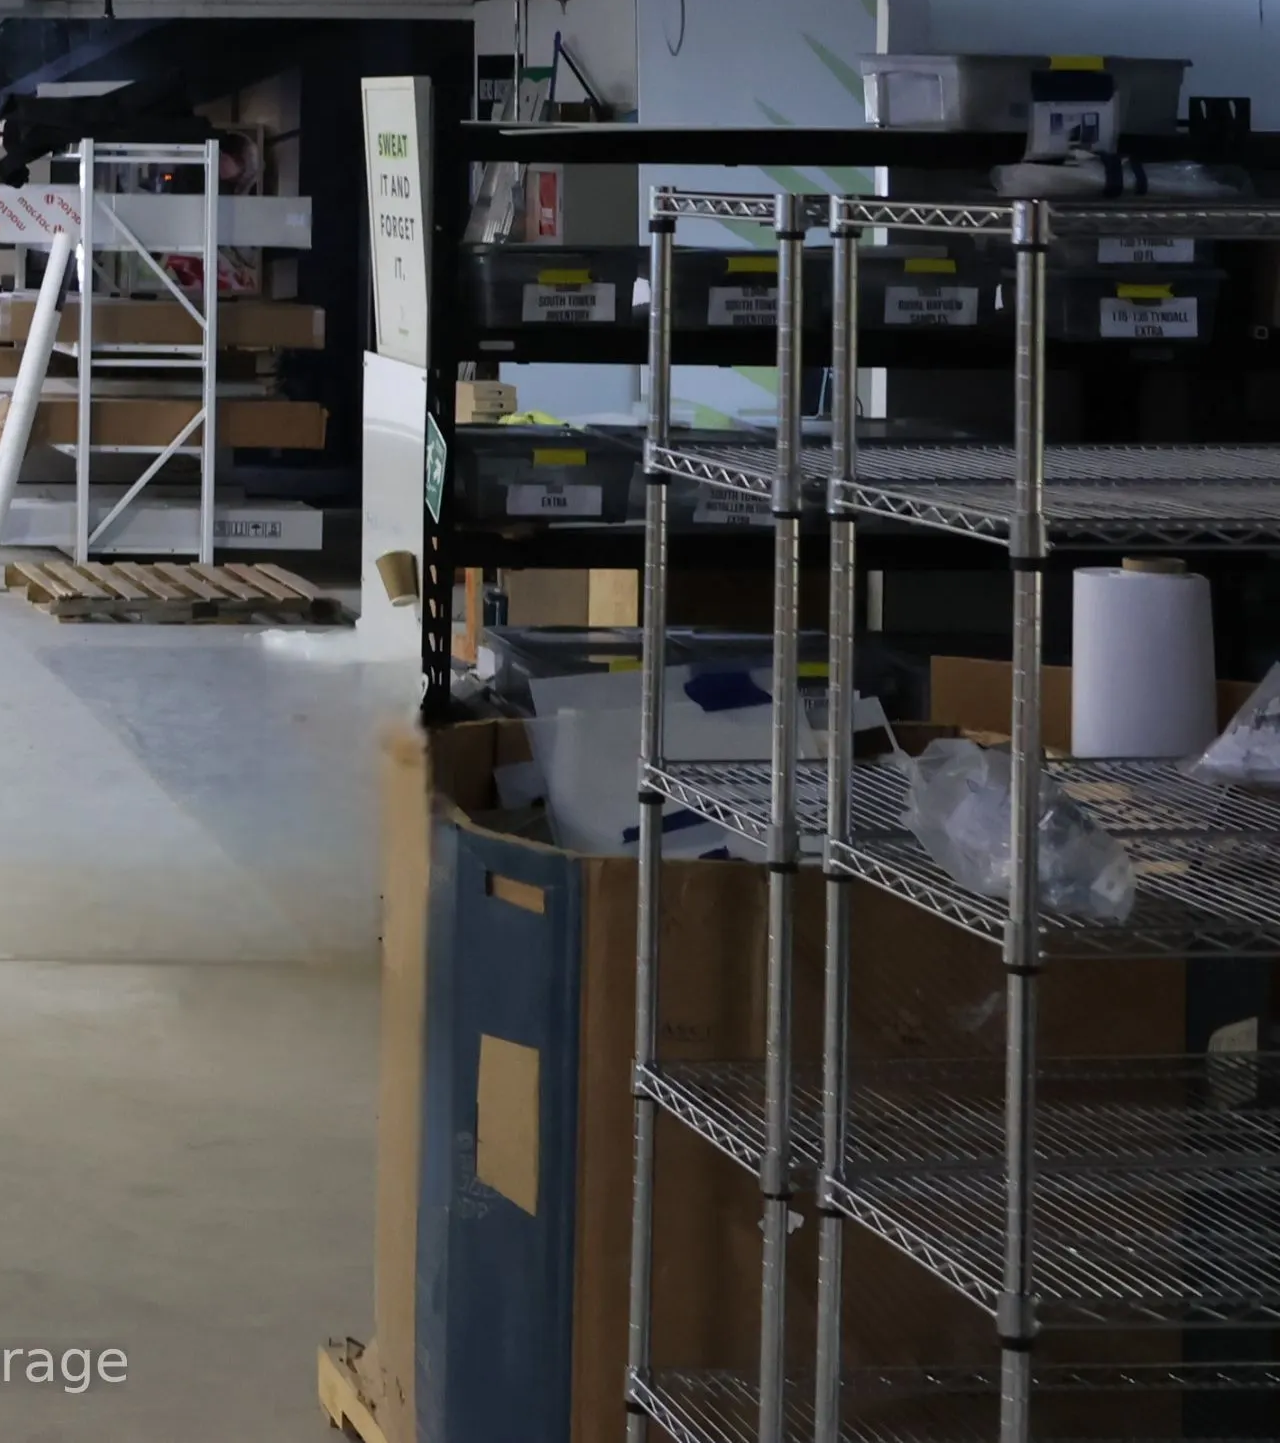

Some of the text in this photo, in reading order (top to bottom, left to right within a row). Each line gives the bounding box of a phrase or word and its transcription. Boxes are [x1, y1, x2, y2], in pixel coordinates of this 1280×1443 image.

[377, 133, 408, 157] SWEAT
[379, 174, 410, 199] IT AND
[56, 196, 82, 226] actac
[380, 214, 415, 241] FORGET
[393, 257, 406, 281] IT.
